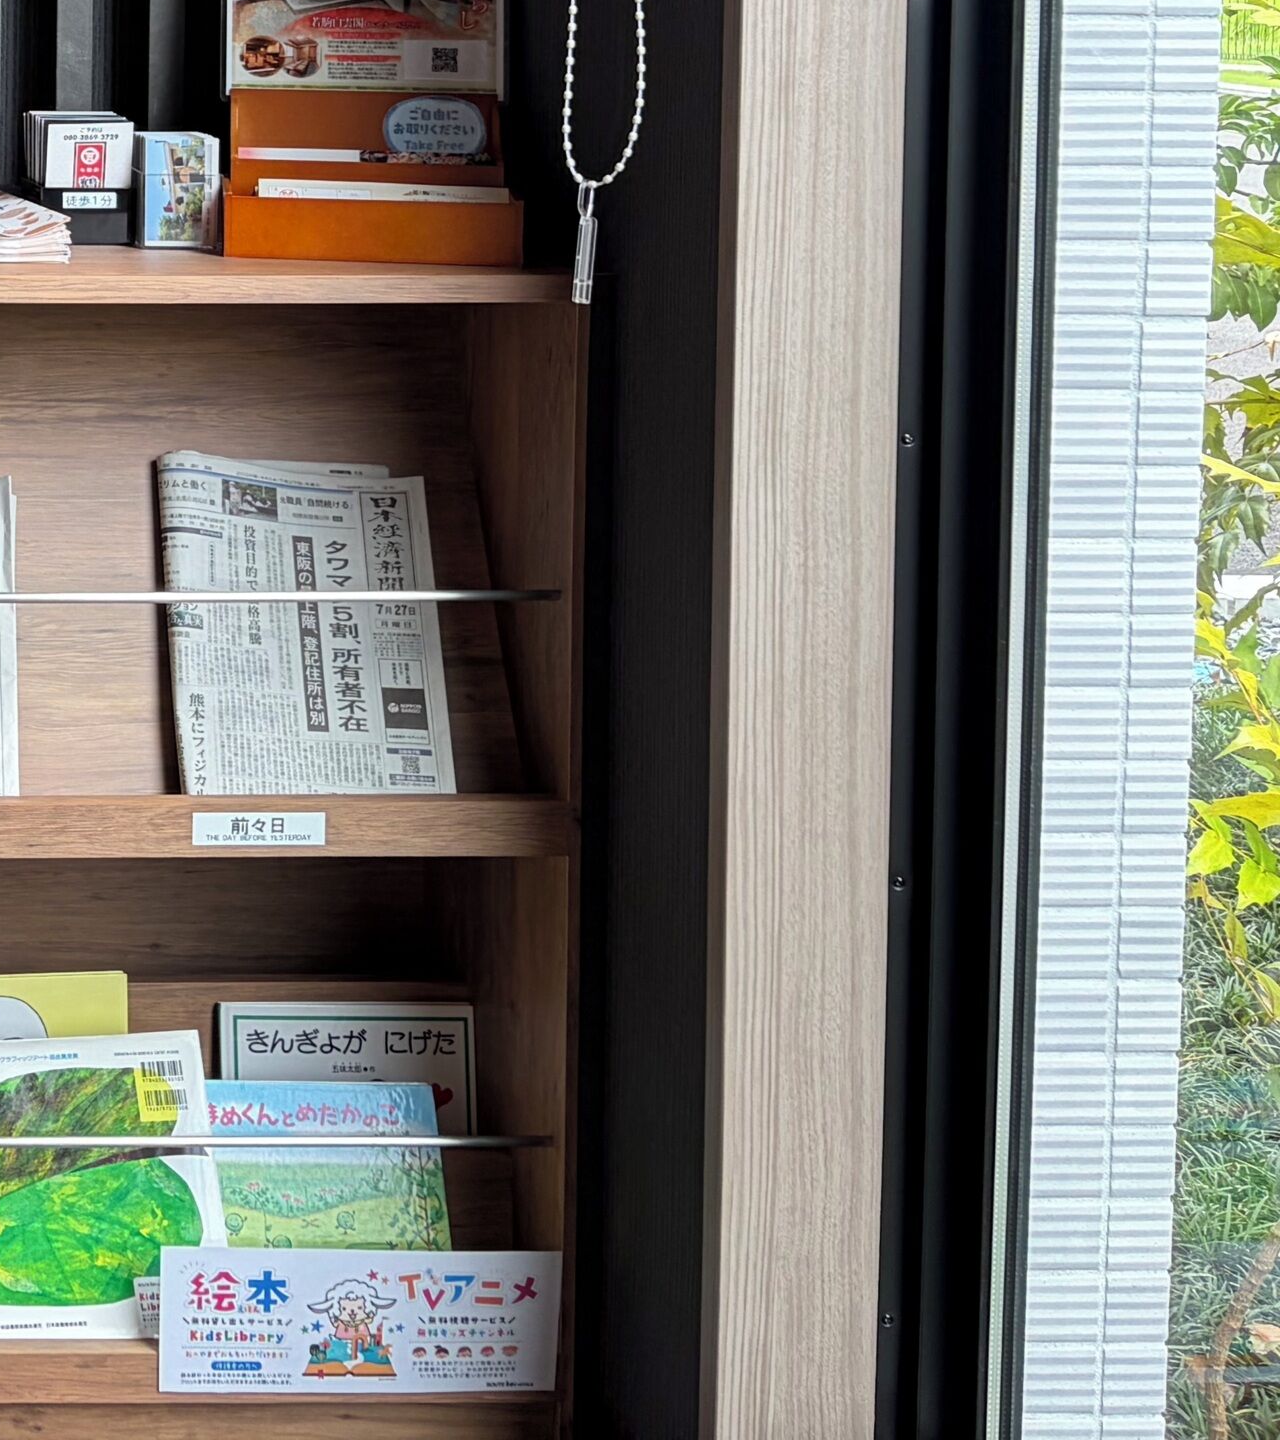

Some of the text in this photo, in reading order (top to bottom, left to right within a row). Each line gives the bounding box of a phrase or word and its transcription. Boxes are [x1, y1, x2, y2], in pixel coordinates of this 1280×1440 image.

[408, 107, 459, 122] ご自由に
[393, 122, 475, 136] お取りください
[404, 140, 465, 151] Take Free
[66, 196, 113, 207] 徒歩1分
[367, 497, 404, 591] 日本経済新聞
[243, 524, 263, 646] 投資目的で格高騰
[375, 603, 416, 617] 7月27日
[324, 539, 369, 733] タワマ5割、所有者不在
[230, 816, 285, 836] 前々日
[245, 1028, 457, 1056] きんぎょが にげた
[187, 1270, 290, 1313] 絵本
[398, 1273, 539, 1311] TVアニメ
[191, 1317, 283, 1326] 無料貸し出しサービス
[428, 1316, 506, 1325] 無料視聴サービス
[189, 1330, 284, 1344] KidsLibrary
[417, 1328, 515, 1337] 無料キッズチャンネル
